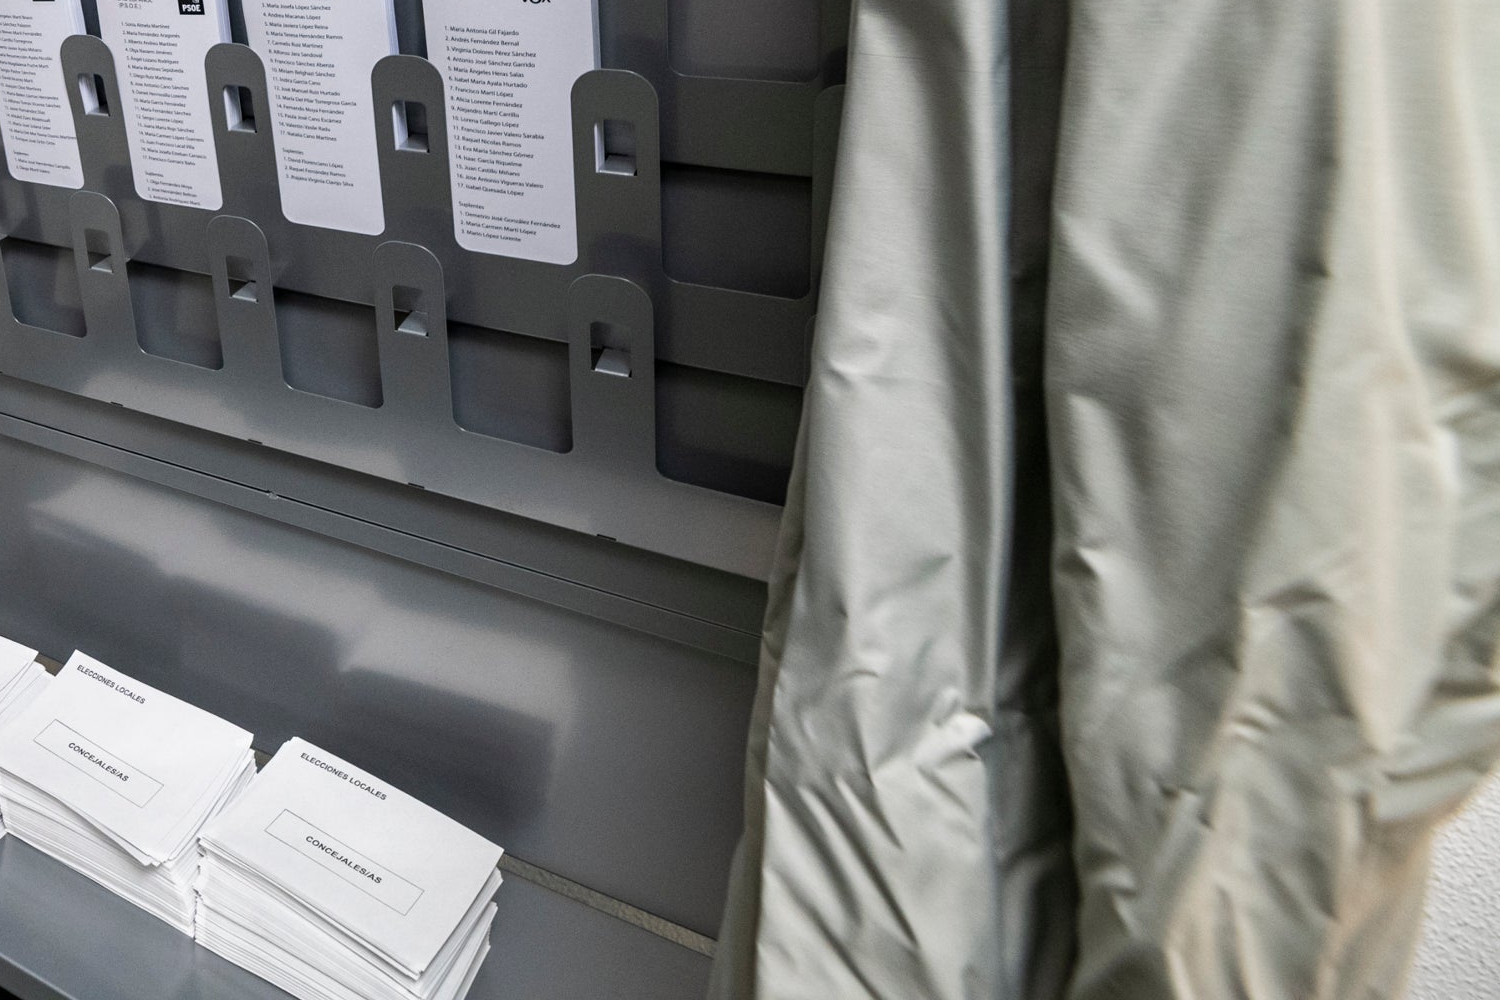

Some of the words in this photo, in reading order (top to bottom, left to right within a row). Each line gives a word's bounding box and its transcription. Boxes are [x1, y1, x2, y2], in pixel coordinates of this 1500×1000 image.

[77, 665, 115, 688] ELECCIONES
[115, 685, 145, 704] LOCALES
[68, 743, 129, 781] CONCEJALES/AS
[300, 752, 348, 780] ELECCIONES
[349, 778, 387, 800] LOCALES
[306, 836, 382, 883] CONCEJALES/AS
